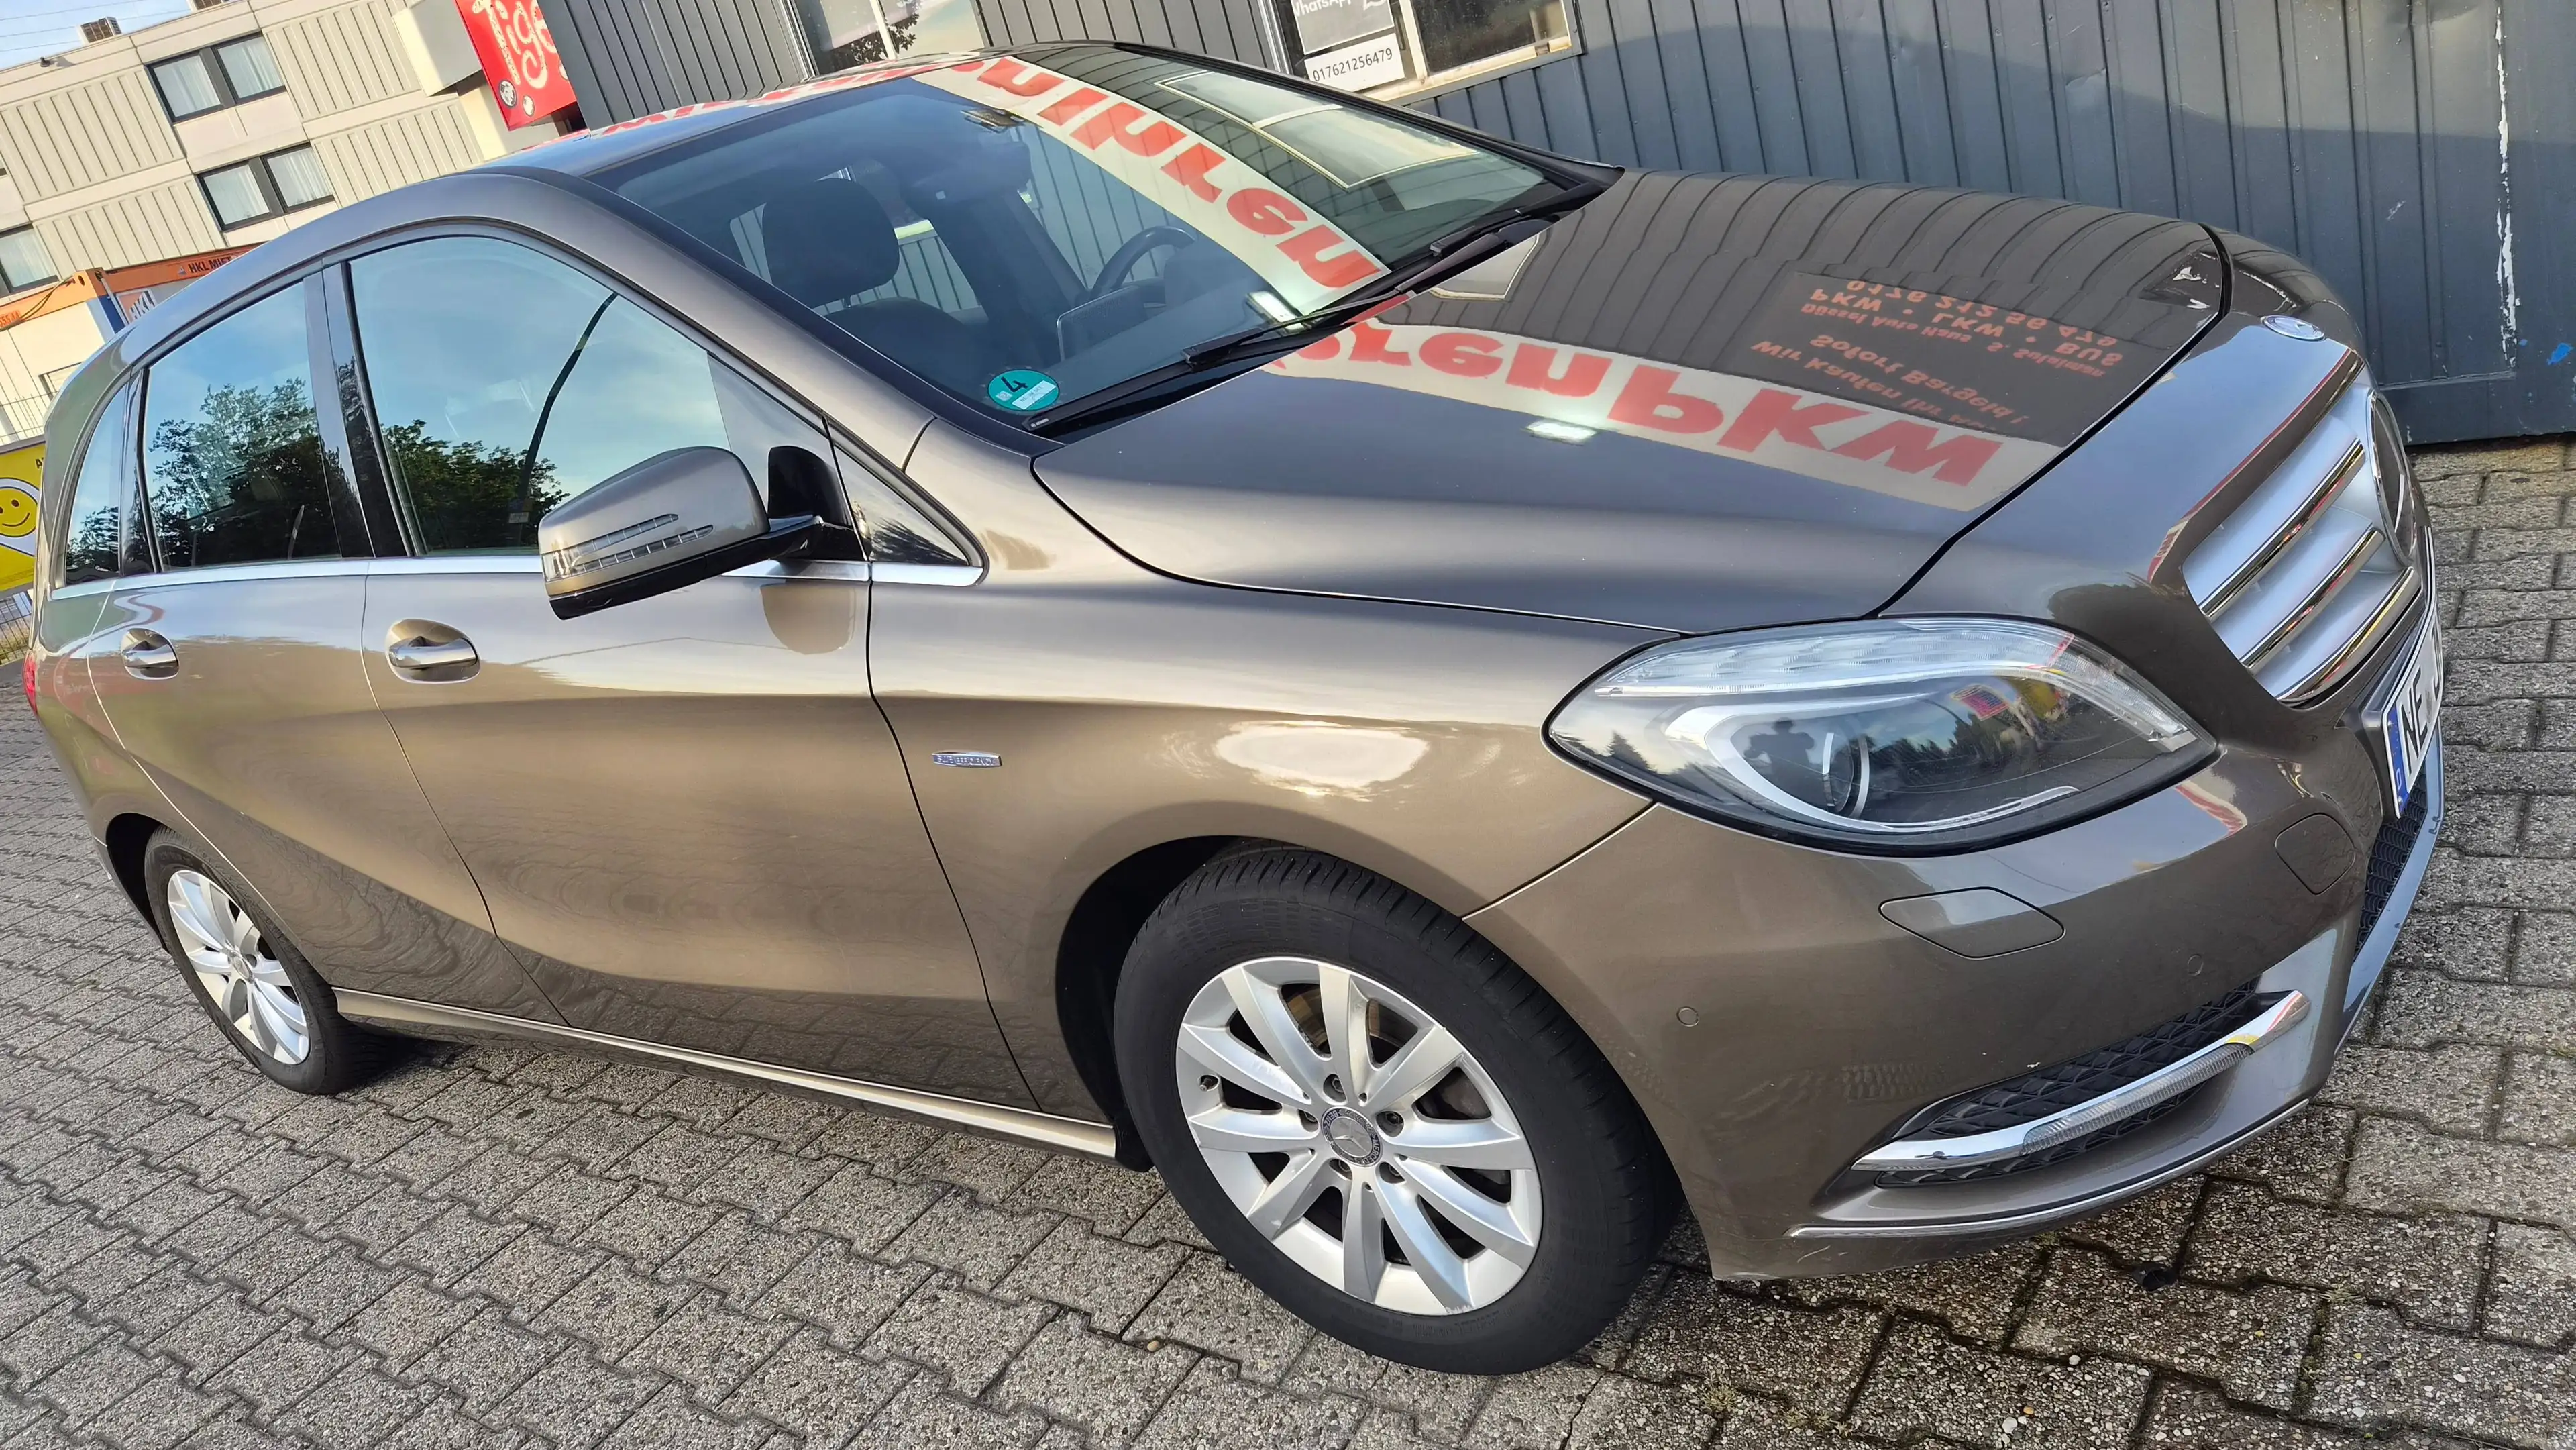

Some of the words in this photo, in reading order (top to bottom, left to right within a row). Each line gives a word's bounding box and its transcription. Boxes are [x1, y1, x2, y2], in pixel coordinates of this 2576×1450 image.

[1313, 48, 1393, 81] 017621256479
[188, 261, 209, 273] HKL
[1001, 376, 1029, 393] 4
[2400, 665, 2428, 778] NE
